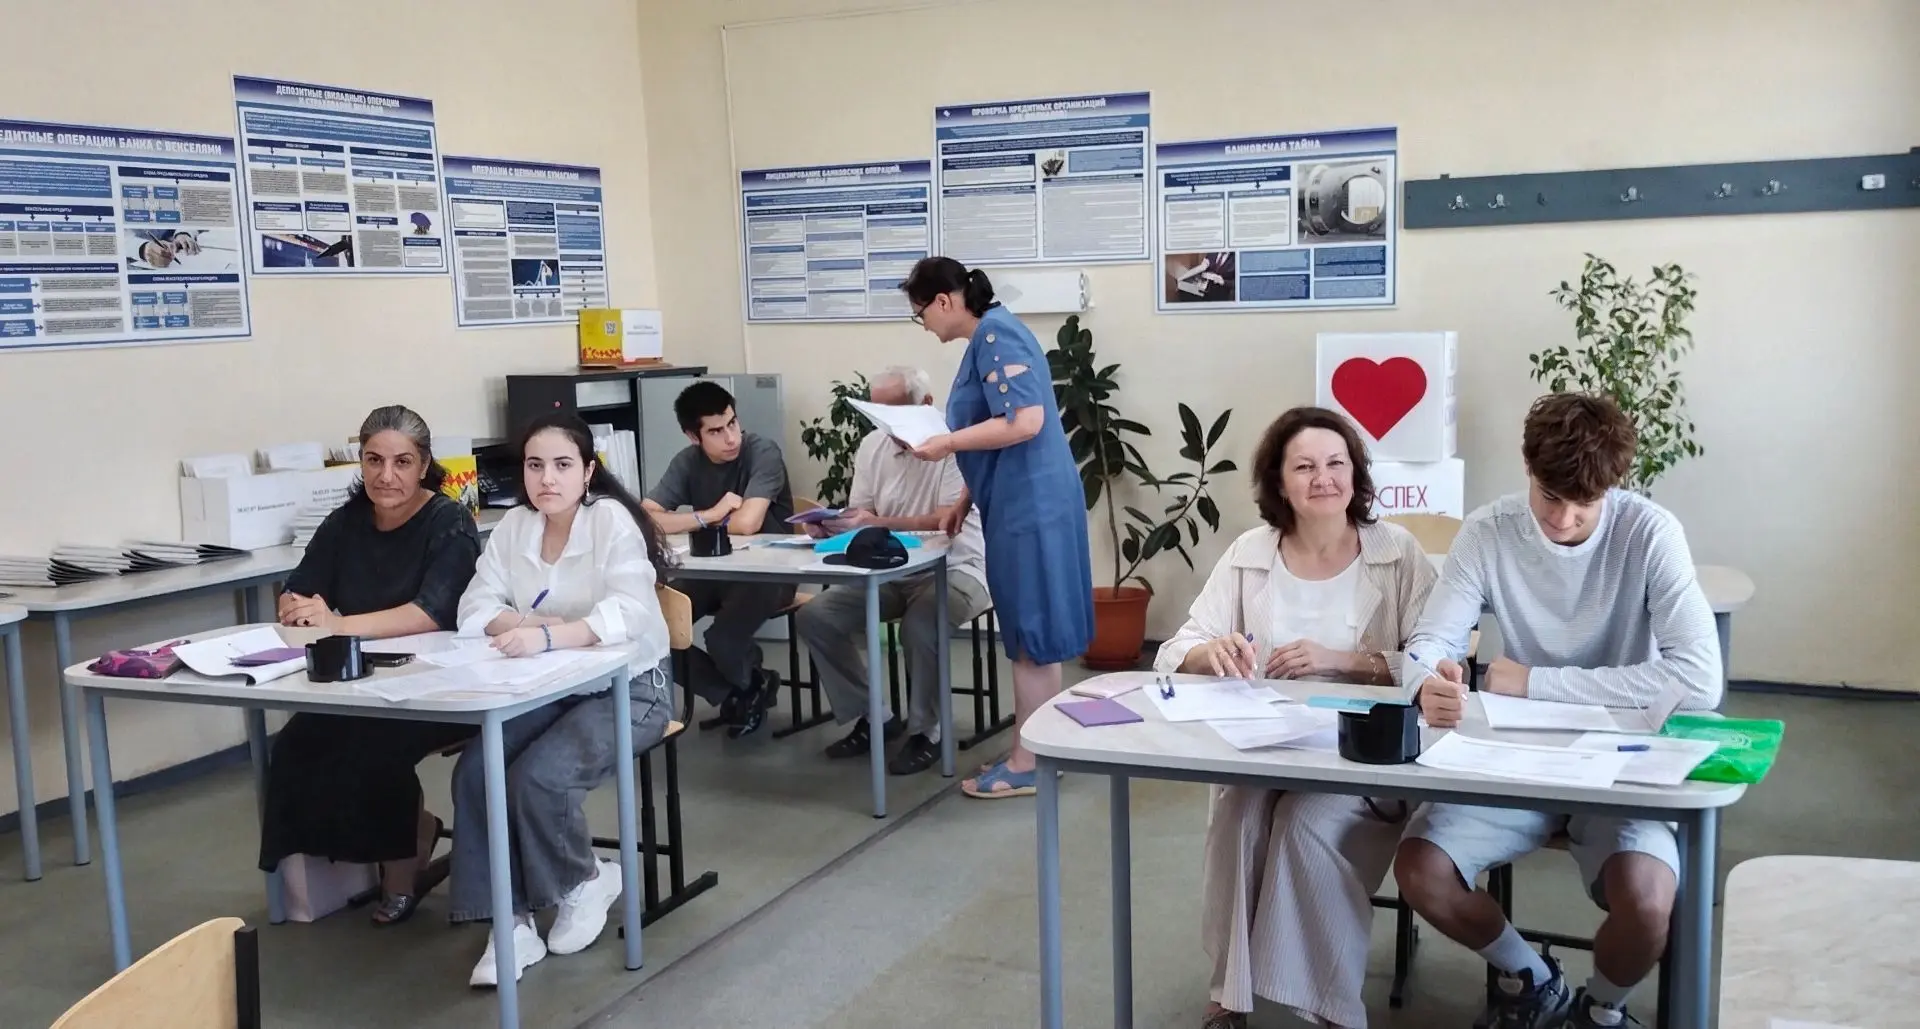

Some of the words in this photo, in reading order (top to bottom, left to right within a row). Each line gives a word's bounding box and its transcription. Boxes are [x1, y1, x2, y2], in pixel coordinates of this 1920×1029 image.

[276, 85, 322, 99] ДЕПОЗИТНЫЕ
[367, 95, 400, 108] ОПЕРАЦИИ
[972, 106, 1007, 116] ПРОВЕРКА
[1008, 102, 1052, 114] КРЕДИТНЫХ
[1053, 98, 1106, 111] ОРГАНИЗАЦИЙ
[57, 133, 116, 149] ОПЕРАЦИИ
[119, 137, 154, 151] БАНКА
[156, 140, 162, 150] С
[165, 141, 222, 155] ВЕКСЕЛЯМИ
[1224, 142, 1286, 155] БАНКОВСКАЯ
[1289, 138, 1321, 152] ТАЙНА
[508, 167, 514, 176] С
[1374, 485, 1428, 509] СПЕХ
